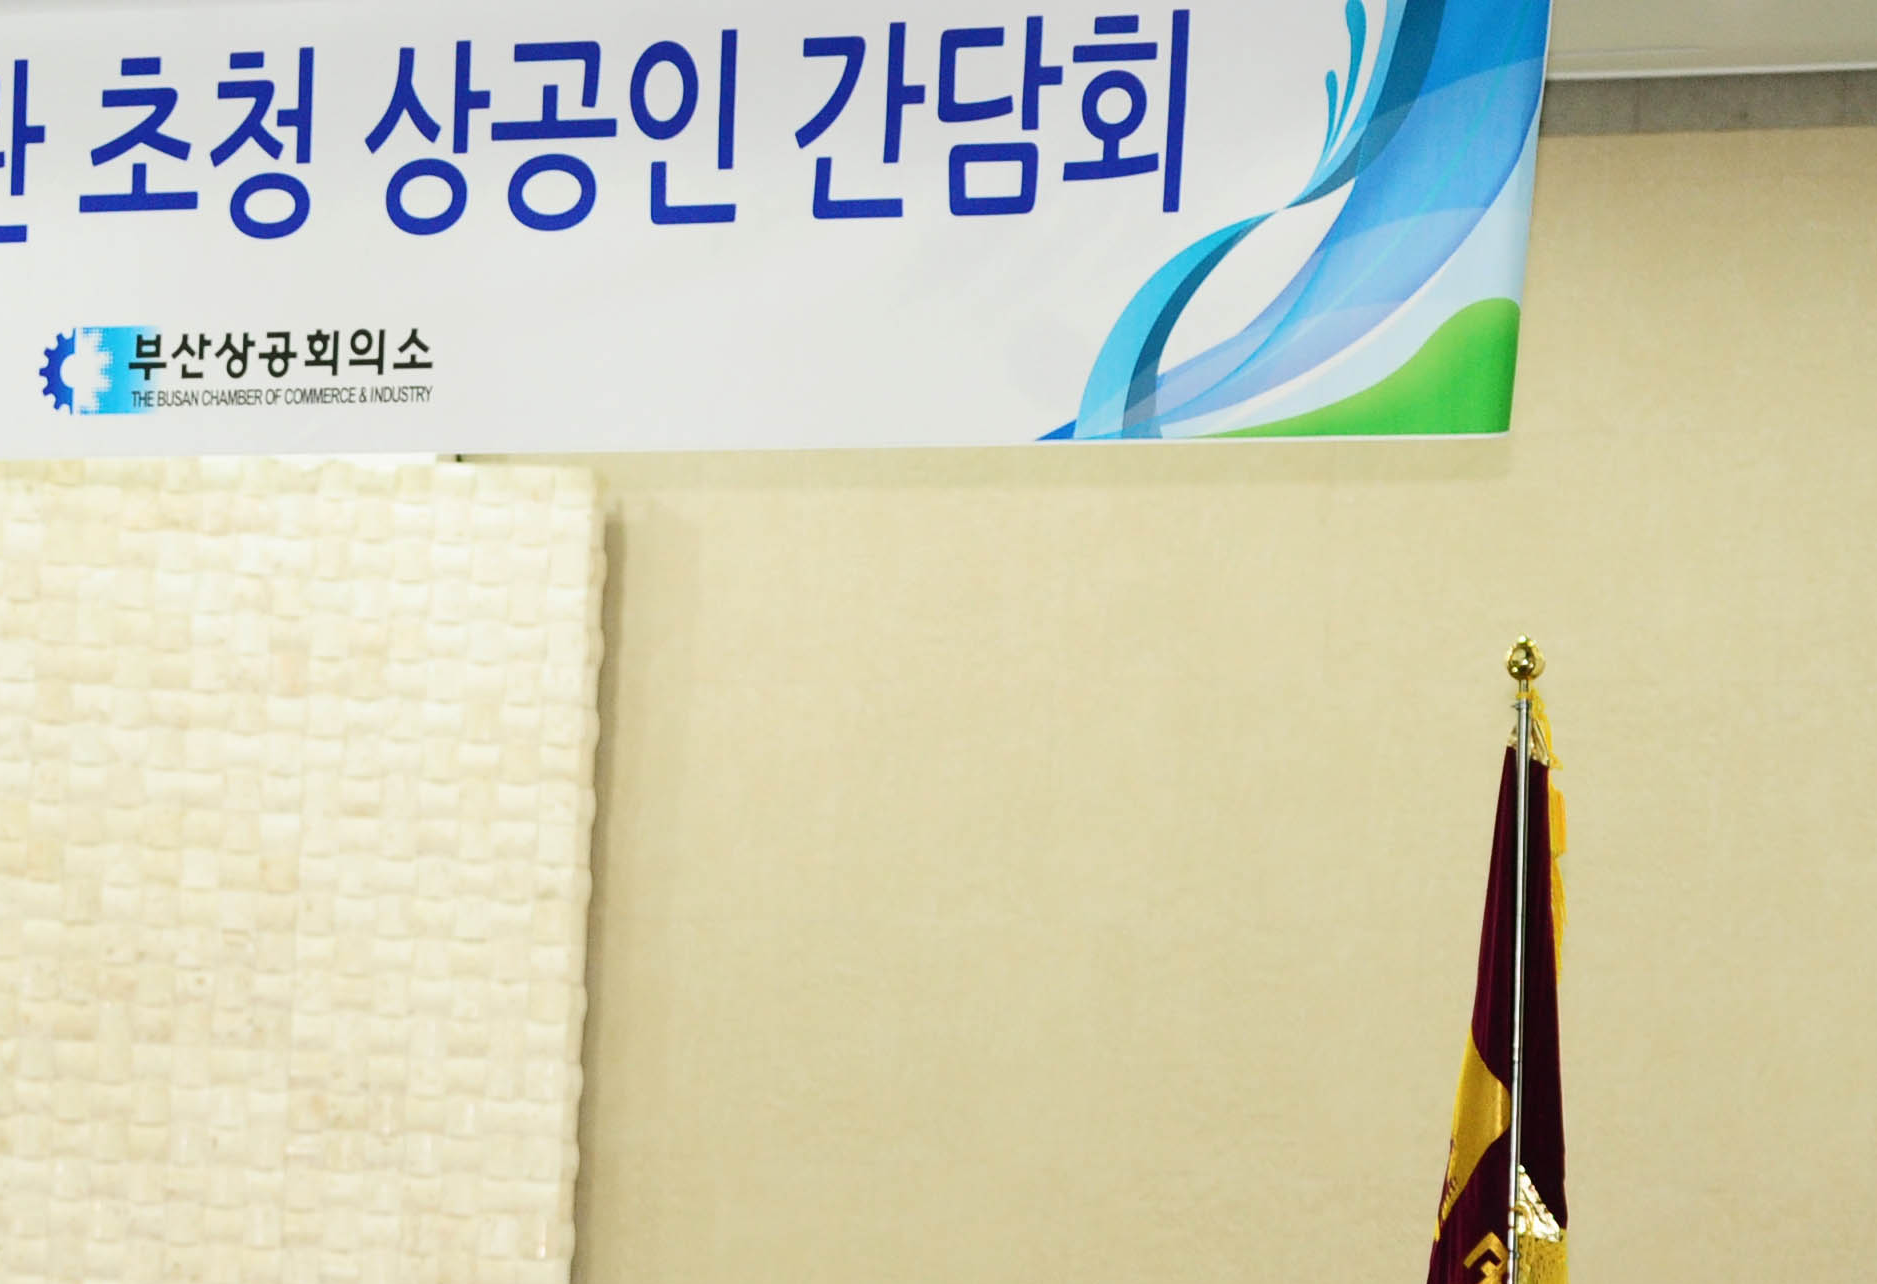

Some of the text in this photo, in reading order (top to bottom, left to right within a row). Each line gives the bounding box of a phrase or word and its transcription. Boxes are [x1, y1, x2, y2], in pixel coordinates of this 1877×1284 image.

[79, 47, 314, 239] 초청
[365, 30, 737, 235] 상공인
[795, 9, 1191, 219] 간담회
[128, 328, 433, 380] 부산상공회의소
[131, 385, 433, 407] THE BUSAN CHAMBER OF COMMERCE & INDUSTRY
